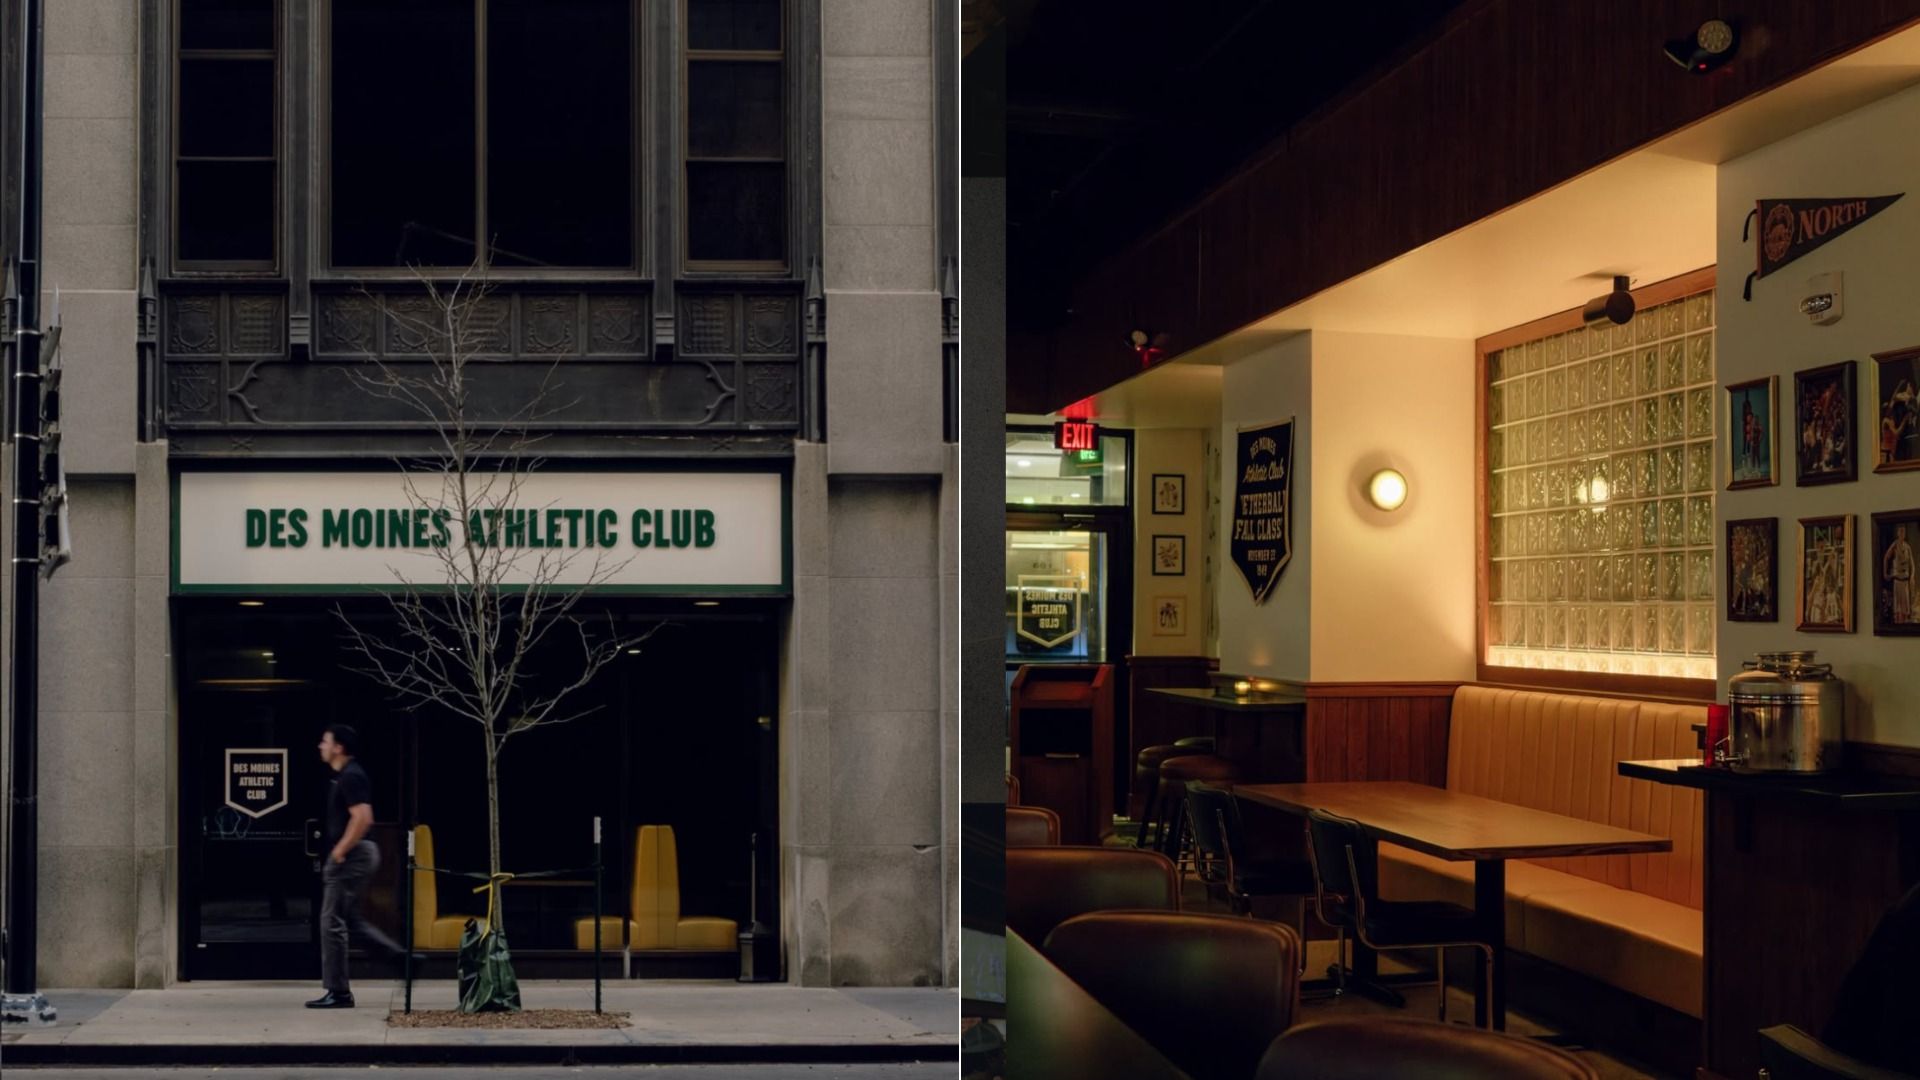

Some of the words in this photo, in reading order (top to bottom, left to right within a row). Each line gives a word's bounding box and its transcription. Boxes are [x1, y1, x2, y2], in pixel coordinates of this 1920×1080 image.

[1796, 201, 1867, 244] NORTH
[1062, 423, 1094, 449] EXIT
[1268, 456, 1284, 480] Club
[245, 508, 309, 549] DES
[321, 508, 452, 549] MOINES
[469, 508, 618, 549] ATHLETIC
[631, 508, 716, 549] CLUB
[233, 763, 248, 773] DES
[250, 763, 280, 773] MOINES
[238, 776, 274, 787] ATHLETIC
[246, 789, 267, 800] CLUB
